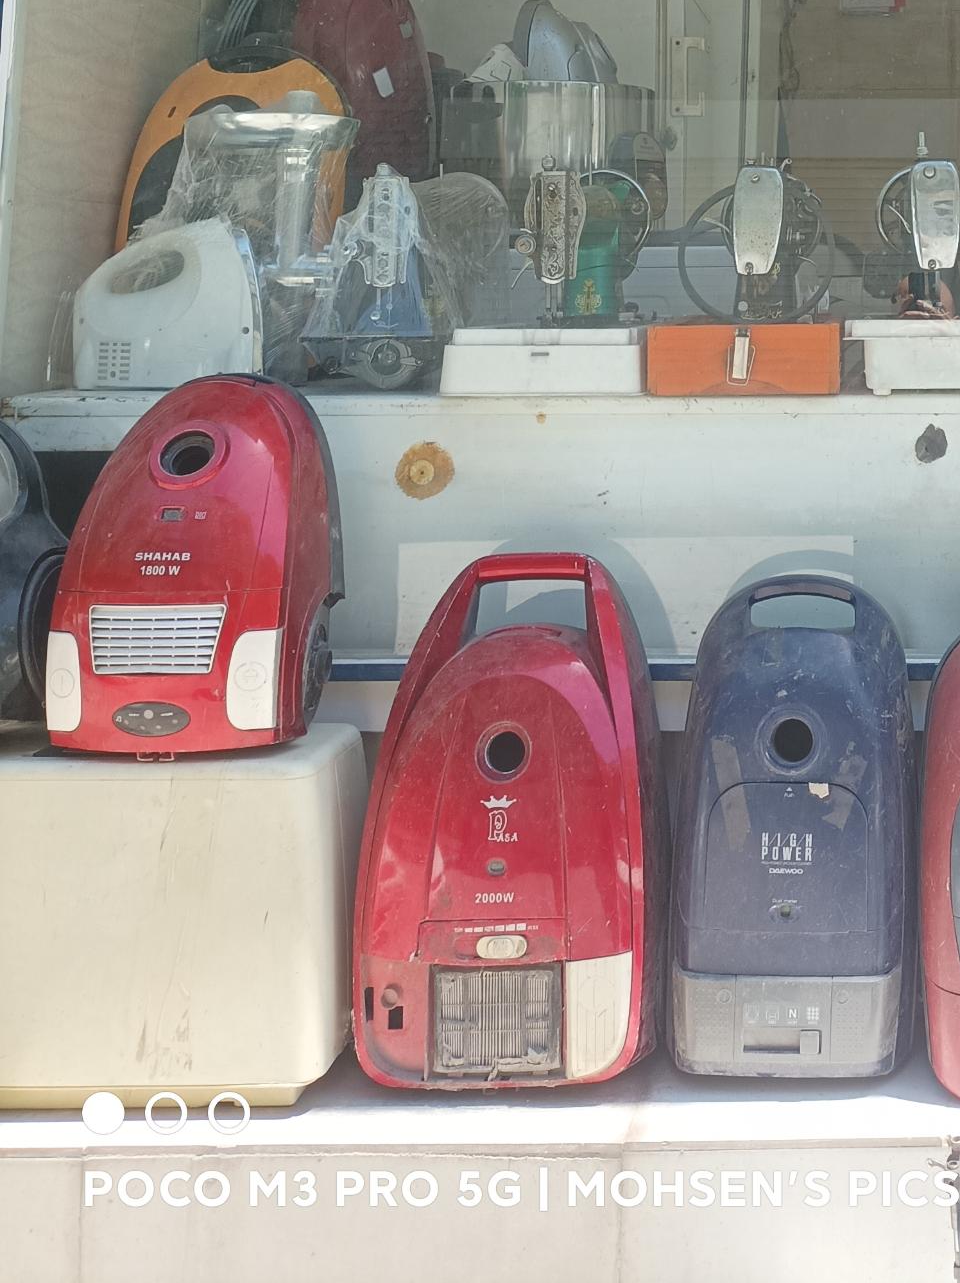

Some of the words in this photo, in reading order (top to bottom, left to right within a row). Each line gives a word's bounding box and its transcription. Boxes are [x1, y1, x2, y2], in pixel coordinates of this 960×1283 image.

[134, 551, 192, 562] SHAHAB
[139, 565, 166, 576] 1800
[167, 565, 181, 576] W
[761, 847, 813, 862] POWER
[768, 867, 804, 875] DAEWOO
[474, 891, 515, 904] 2000W
[788, 1008, 798, 1019] N
